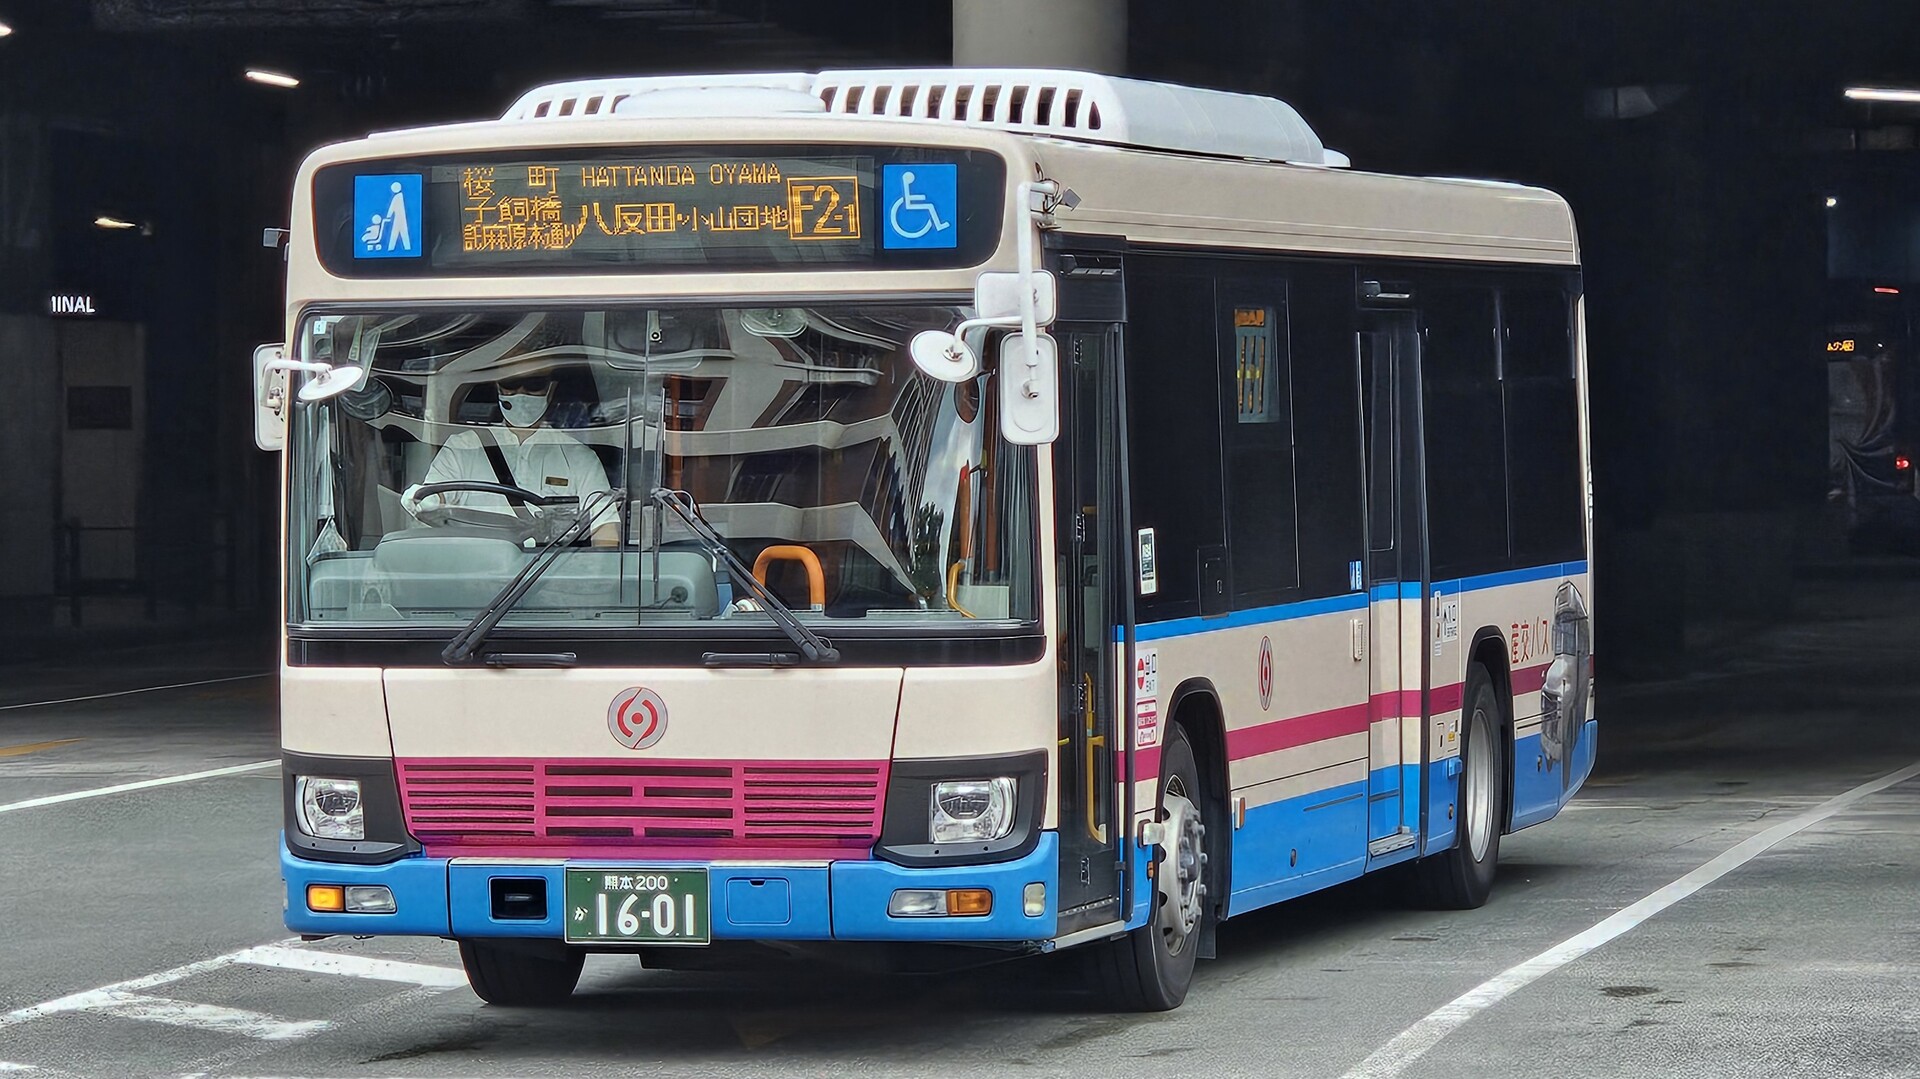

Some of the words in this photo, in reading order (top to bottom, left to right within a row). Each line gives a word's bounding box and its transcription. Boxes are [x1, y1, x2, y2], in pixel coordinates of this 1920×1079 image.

[581, 165, 695, 188] HATTANDA
[709, 163, 781, 186] OYAMA
[464, 195, 562, 223] 子飼橋
[791, 184, 857, 234] F2-1
[1511, 615, 1549, 664] 産交バス
[574, 906, 588, 921] か
[598, 893, 695, 936] 16-01
